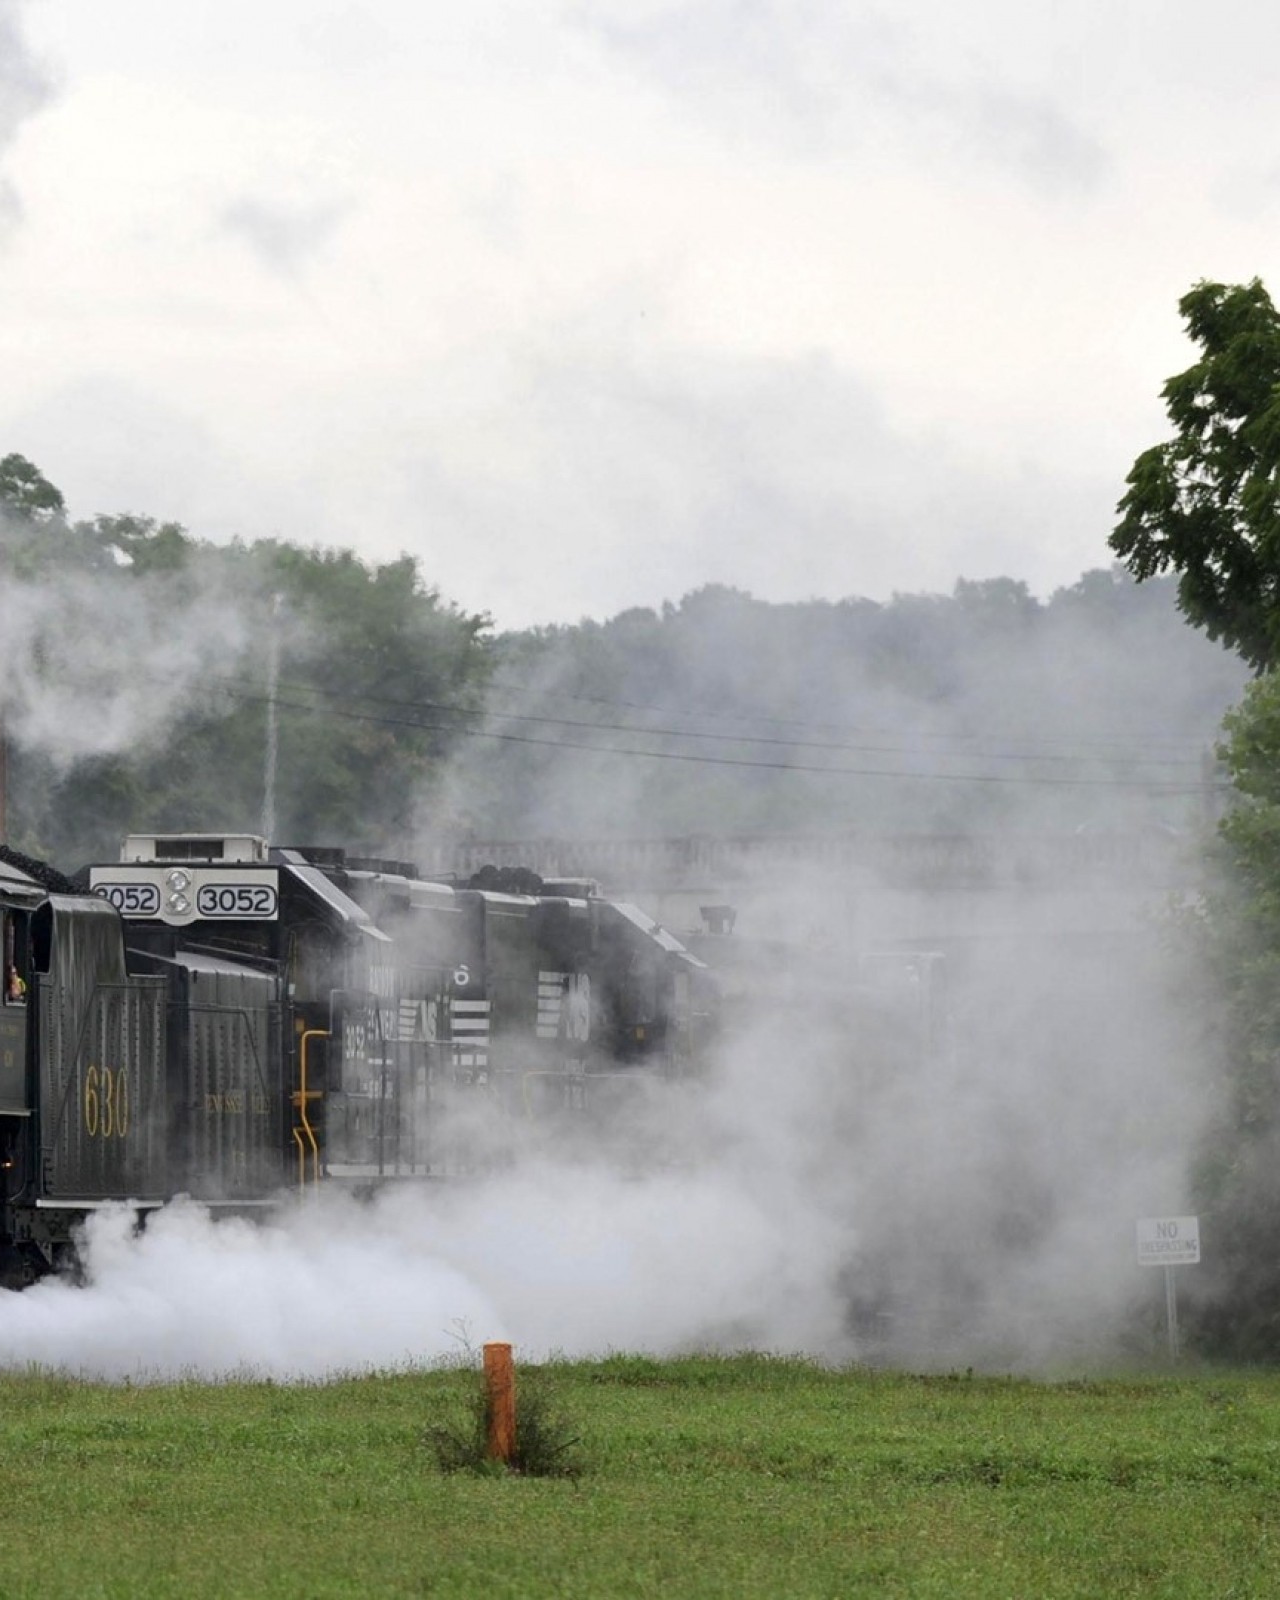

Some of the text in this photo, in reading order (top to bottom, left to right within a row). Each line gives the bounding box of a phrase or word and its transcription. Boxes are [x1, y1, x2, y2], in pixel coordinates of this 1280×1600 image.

[201, 889, 271, 912] 3052
[85, 1066, 128, 1137] 630
[1156, 1221, 1178, 1239] NO
